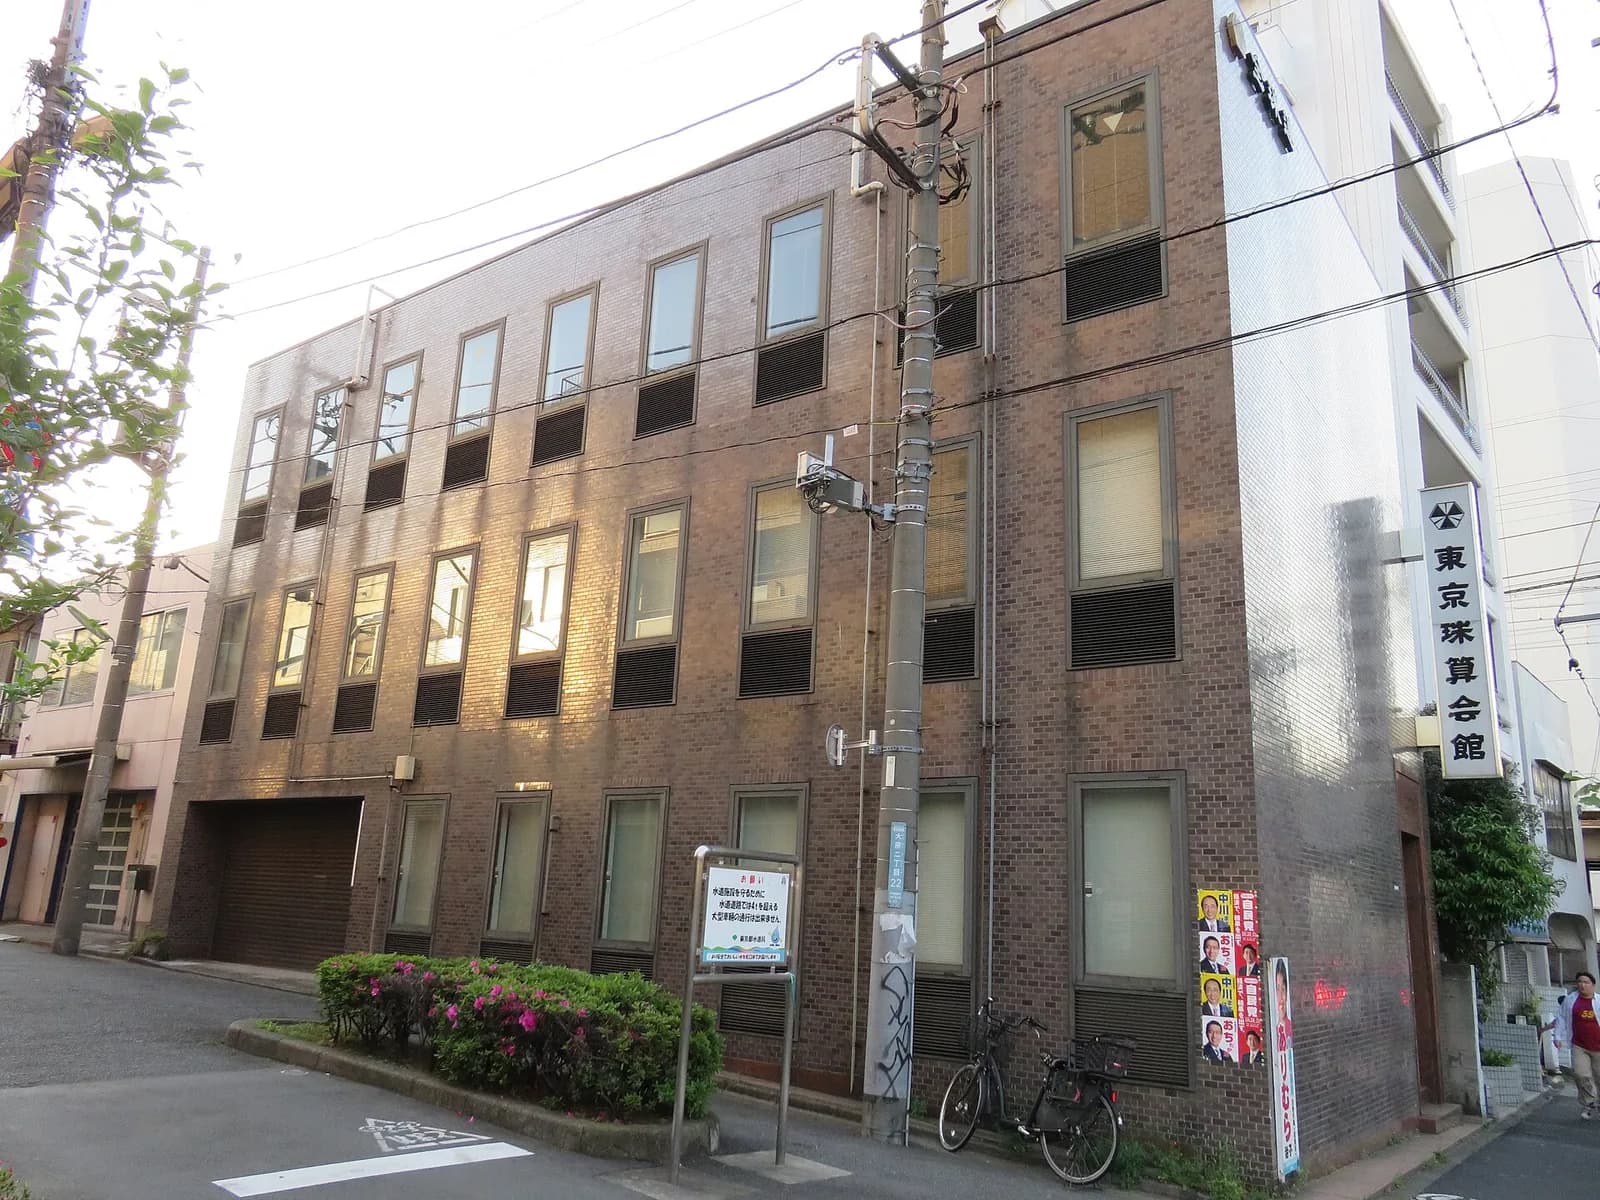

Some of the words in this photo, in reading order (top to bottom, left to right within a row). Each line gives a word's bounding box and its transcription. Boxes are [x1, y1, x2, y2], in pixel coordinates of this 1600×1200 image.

[1434, 545, 1486, 761] 東京珠算会館
[740, 874, 764, 885] お願い
[890, 878, 902, 888] 22
[1219, 893, 1230, 916] 中川
[1242, 899, 1255, 932] 自民党
[1220, 933, 1231, 958] おち
[1221, 976, 1232, 1000] 中川
[1246, 984, 1258, 1017] 自民党
[1223, 1019, 1234, 1043] おち
[1278, 1025, 1292, 1143] ありむら
